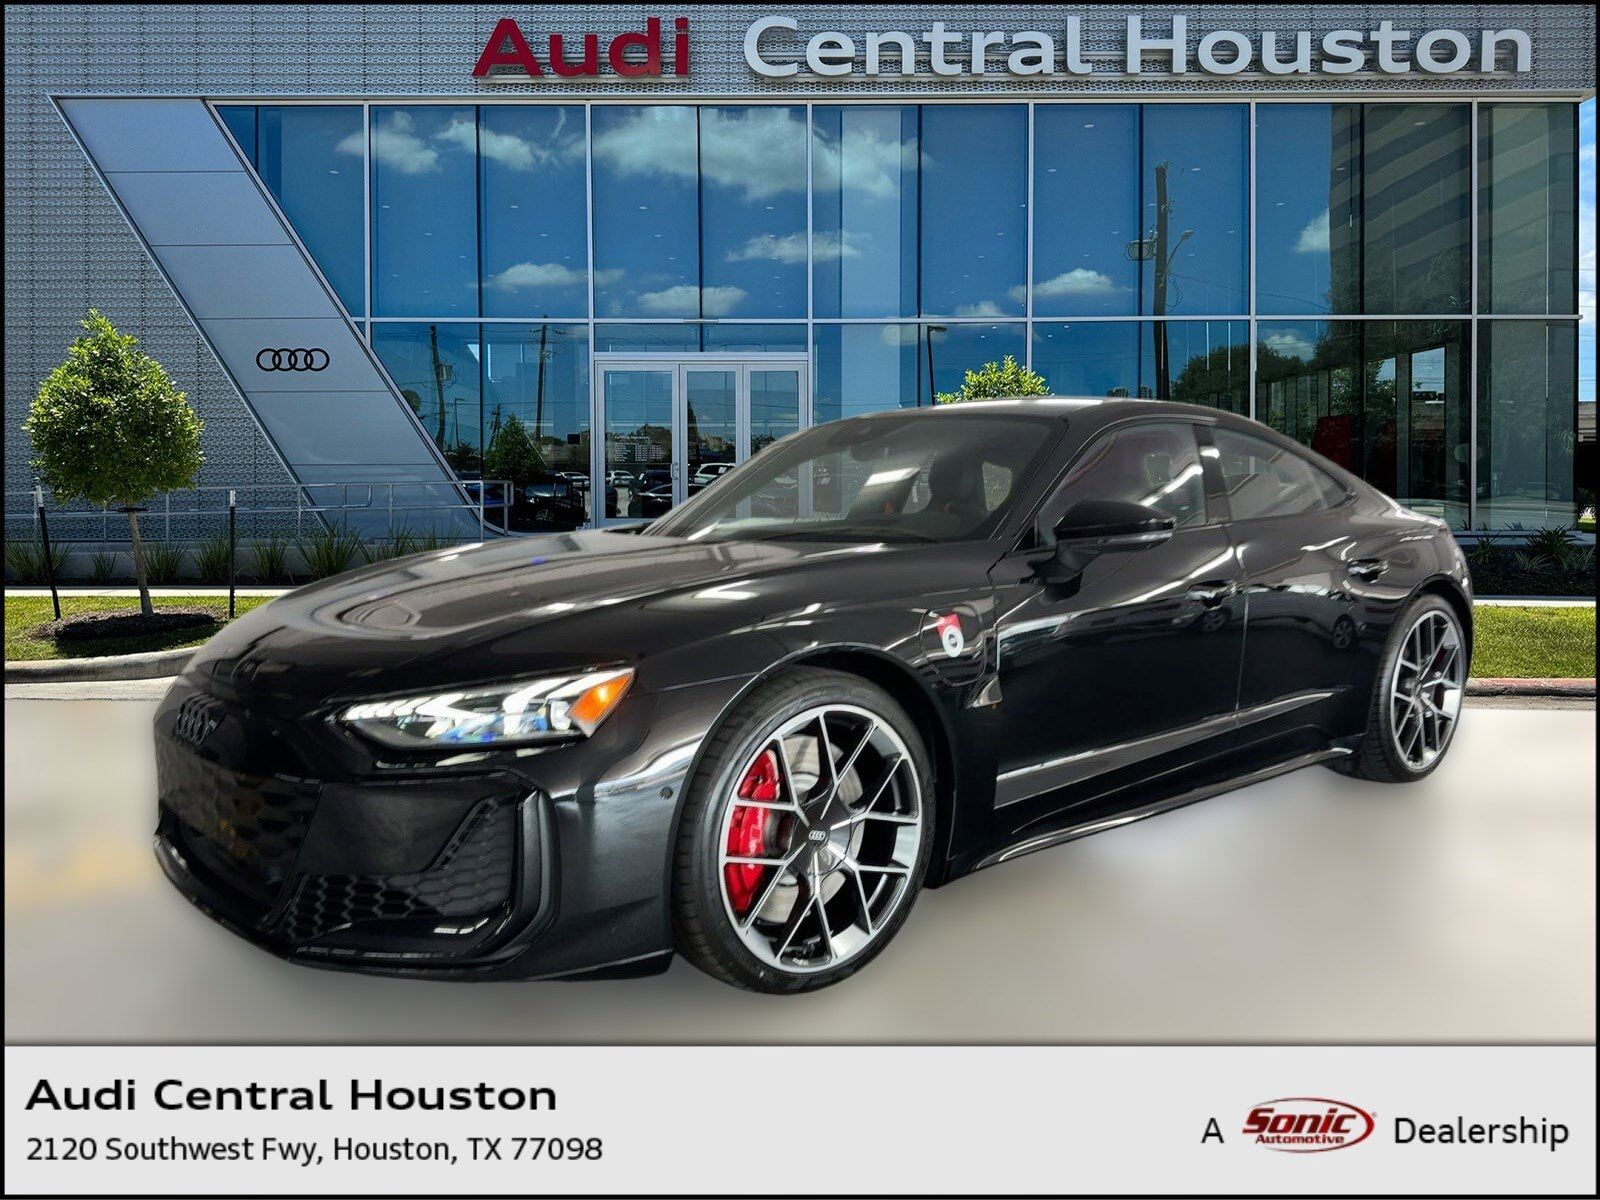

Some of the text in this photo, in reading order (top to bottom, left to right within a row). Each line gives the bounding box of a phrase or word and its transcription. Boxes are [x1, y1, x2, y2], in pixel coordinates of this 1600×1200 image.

[472, 15, 1532, 78] Audi Central Houston
